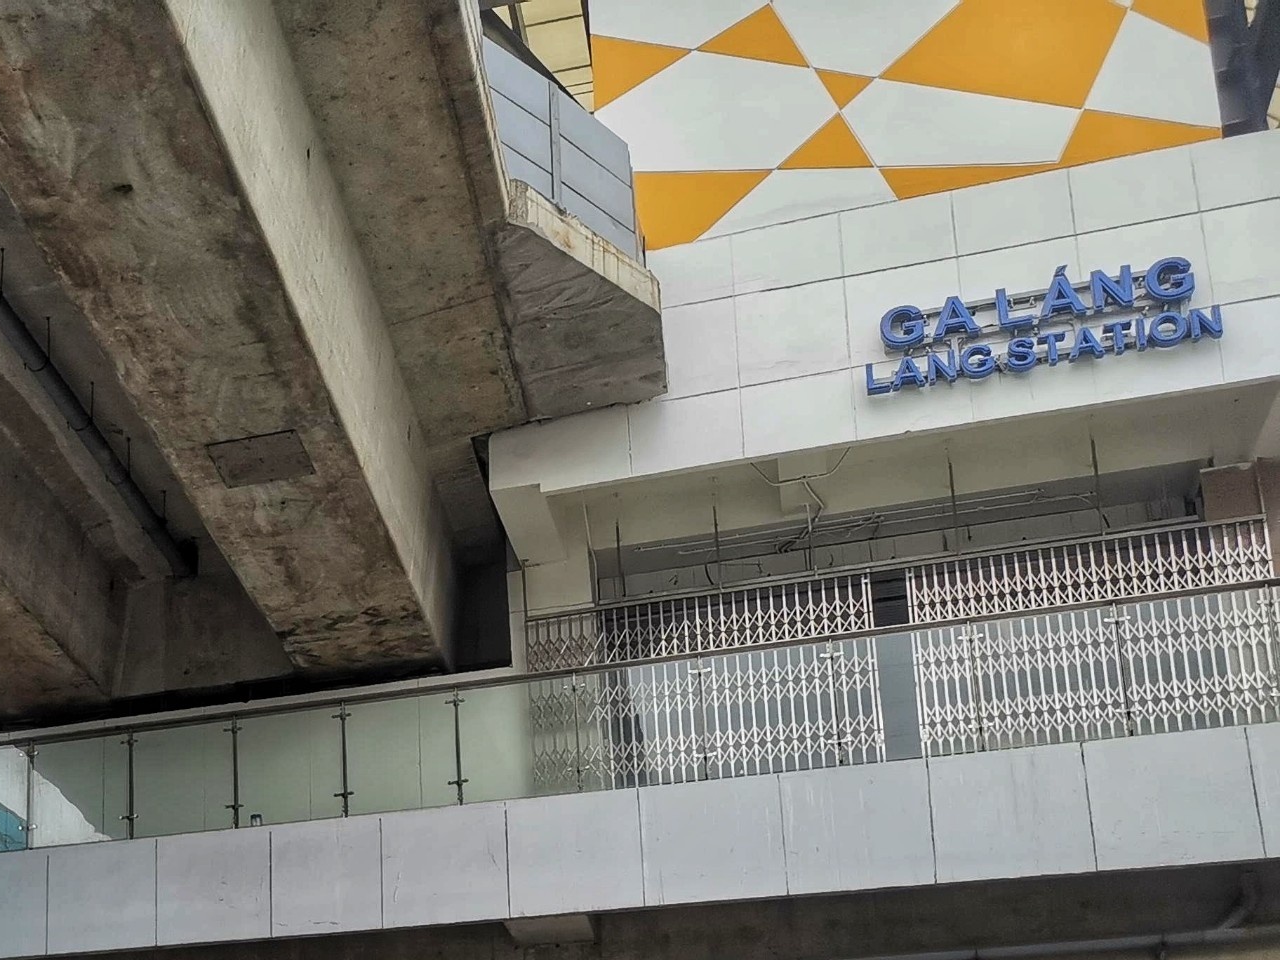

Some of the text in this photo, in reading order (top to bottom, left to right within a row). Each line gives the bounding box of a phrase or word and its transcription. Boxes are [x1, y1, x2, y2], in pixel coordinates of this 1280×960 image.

[880, 256, 1196, 350] GA LÁNG
[866, 305, 1224, 396] LANG STATION
